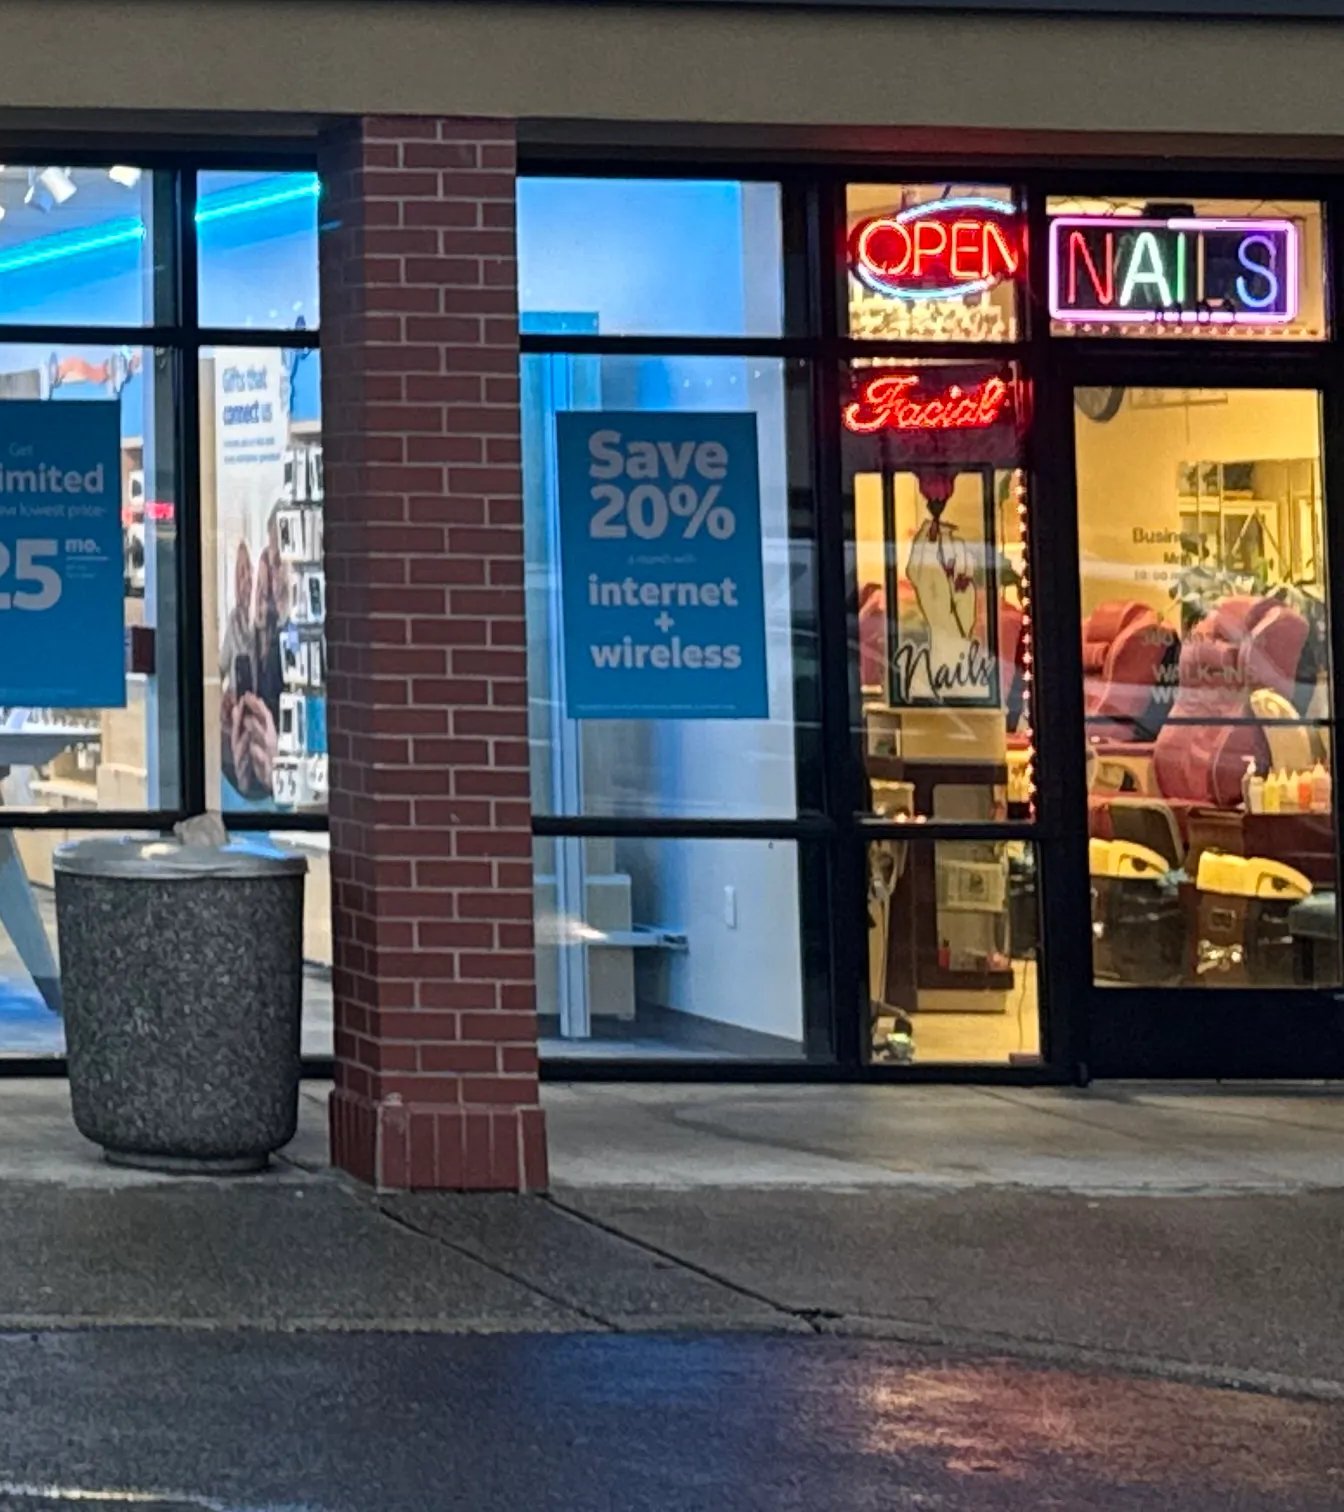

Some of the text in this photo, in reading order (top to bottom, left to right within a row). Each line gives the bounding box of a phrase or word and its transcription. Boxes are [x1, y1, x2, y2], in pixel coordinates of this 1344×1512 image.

[856, 218, 1019, 281] OPEN
[1067, 230, 1280, 309] NAILS
[843, 374, 1007, 434] Facial
[587, 429, 729, 481] Save
[588, 484, 736, 539] 20%
[587, 573, 739, 607] internet
[589, 636, 742, 670] wireless
[891, 638, 997, 704] Nails
